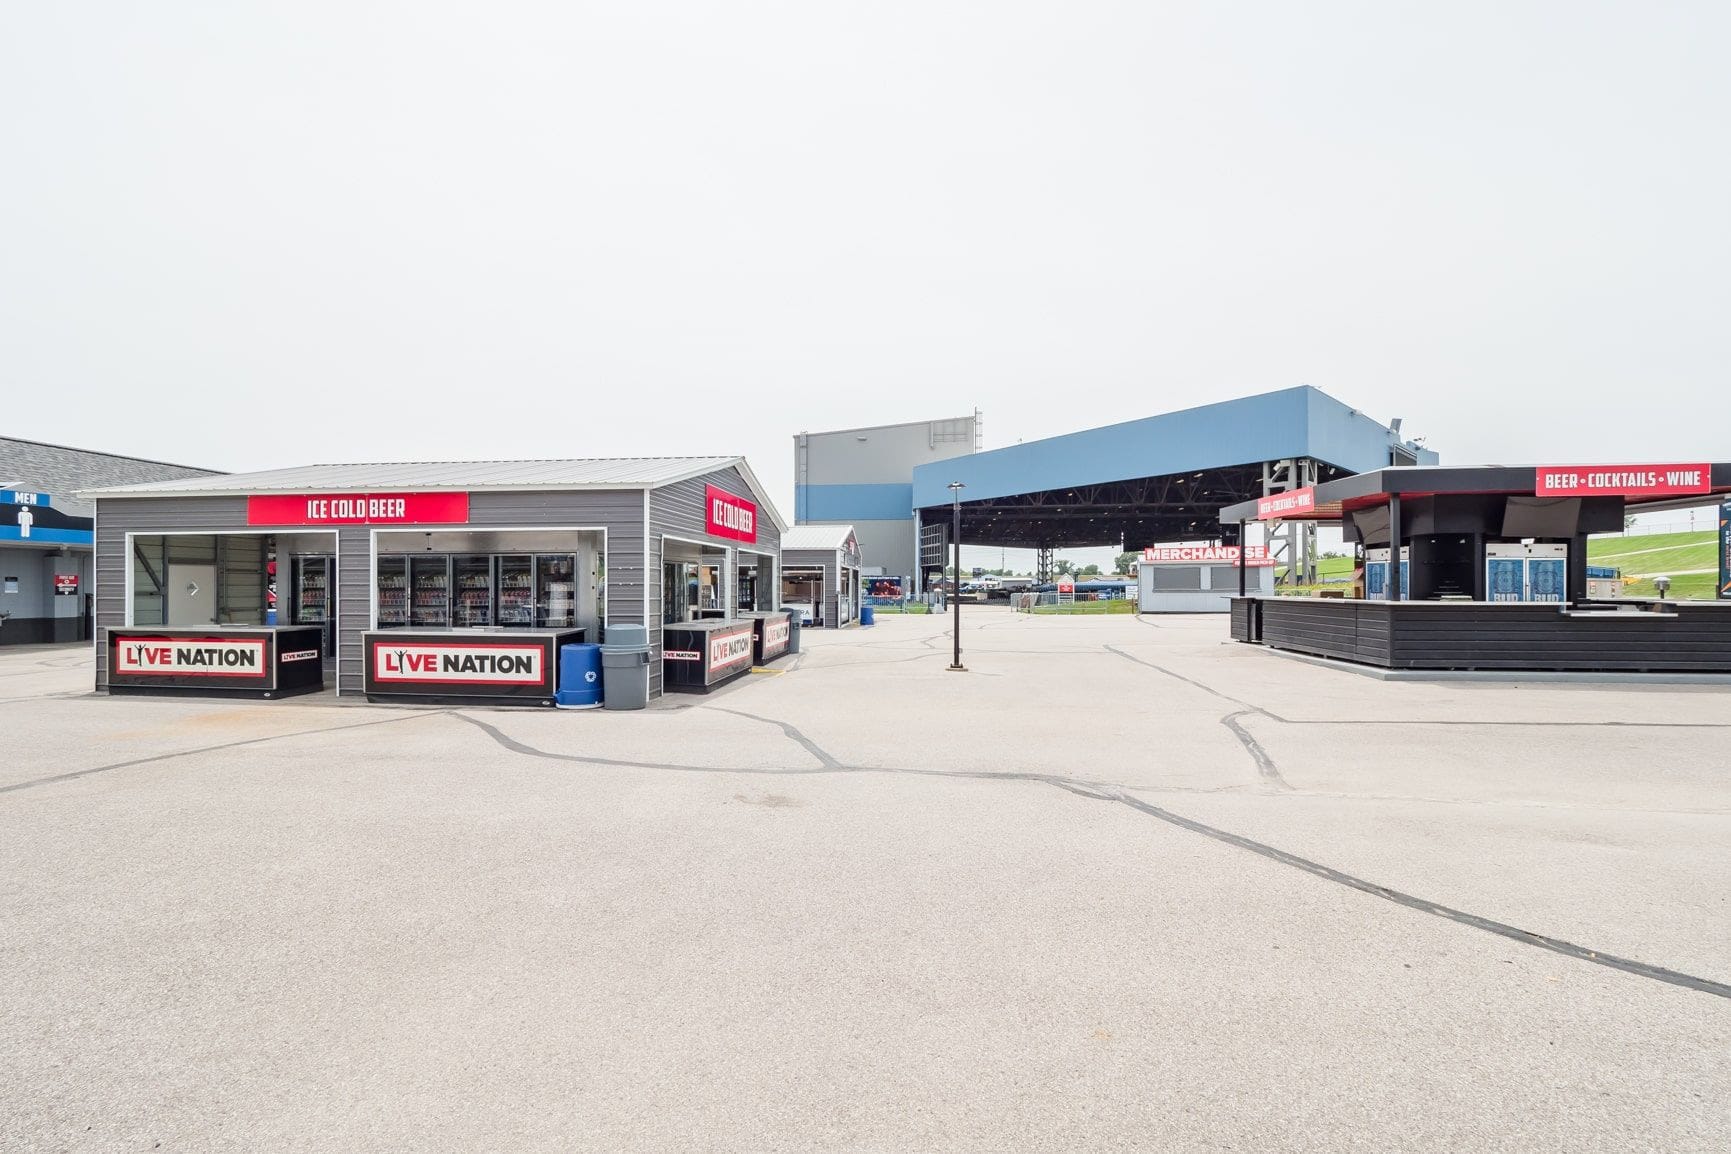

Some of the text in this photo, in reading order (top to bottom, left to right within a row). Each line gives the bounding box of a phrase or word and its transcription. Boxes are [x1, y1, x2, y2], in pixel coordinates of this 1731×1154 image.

[1545, 471, 1701, 489] BEER COCKTAILS WINE
[15, 492, 37, 504] MEN
[307, 498, 405, 518] ICE COLD BEER
[713, 498, 753, 534] ICE COLD BEER
[1146, 546, 1265, 560] MERCHANDSE
[127, 643, 256, 667] LIVE NATION
[675, 651, 698, 659] NATION
[713, 640, 728, 662] LIVE
[385, 650, 533, 674] LIVE NATION
